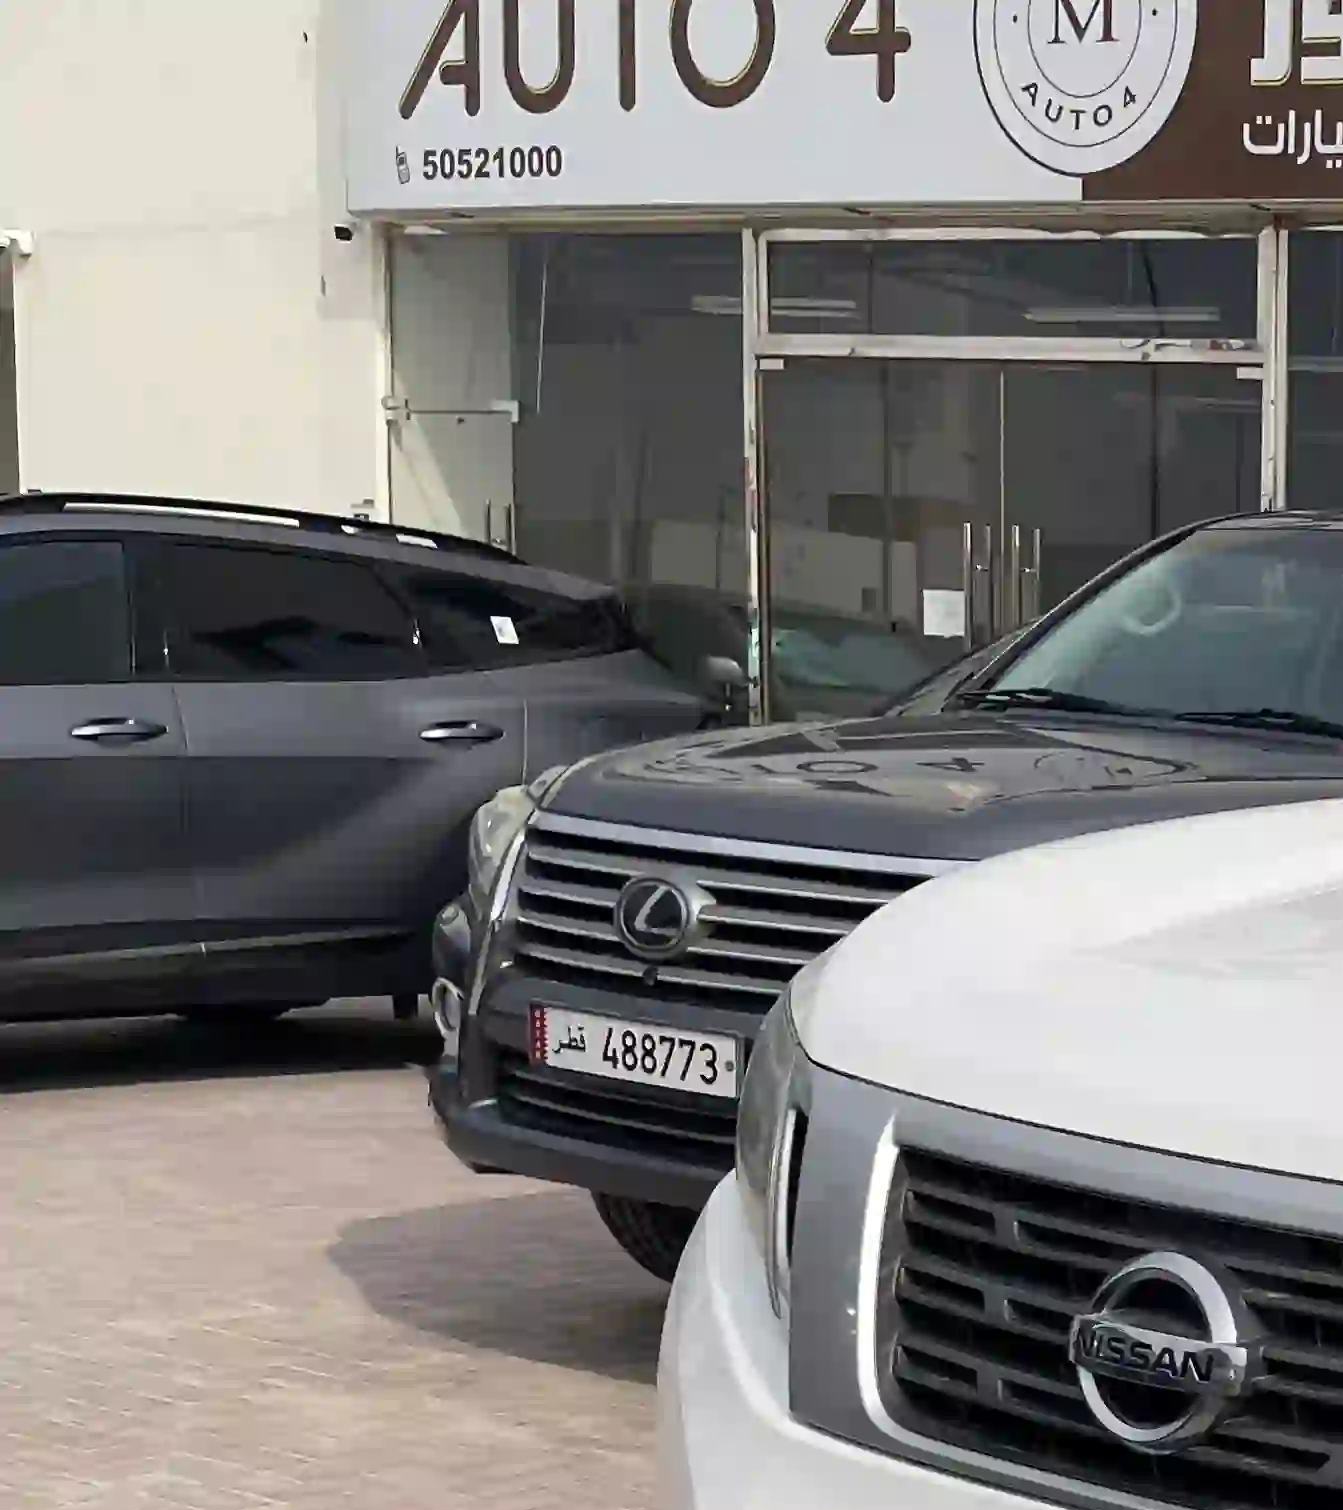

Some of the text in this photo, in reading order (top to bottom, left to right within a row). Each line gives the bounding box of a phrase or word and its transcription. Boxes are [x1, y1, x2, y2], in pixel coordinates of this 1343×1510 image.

[1021, 82, 1136, 130] AUTO 4
[423, 145, 562, 180] 50521000
[552, 1024, 587, 1054] قطر
[602, 1027, 718, 1085] 488773
[1079, 1328, 1213, 1383] NISSAN
